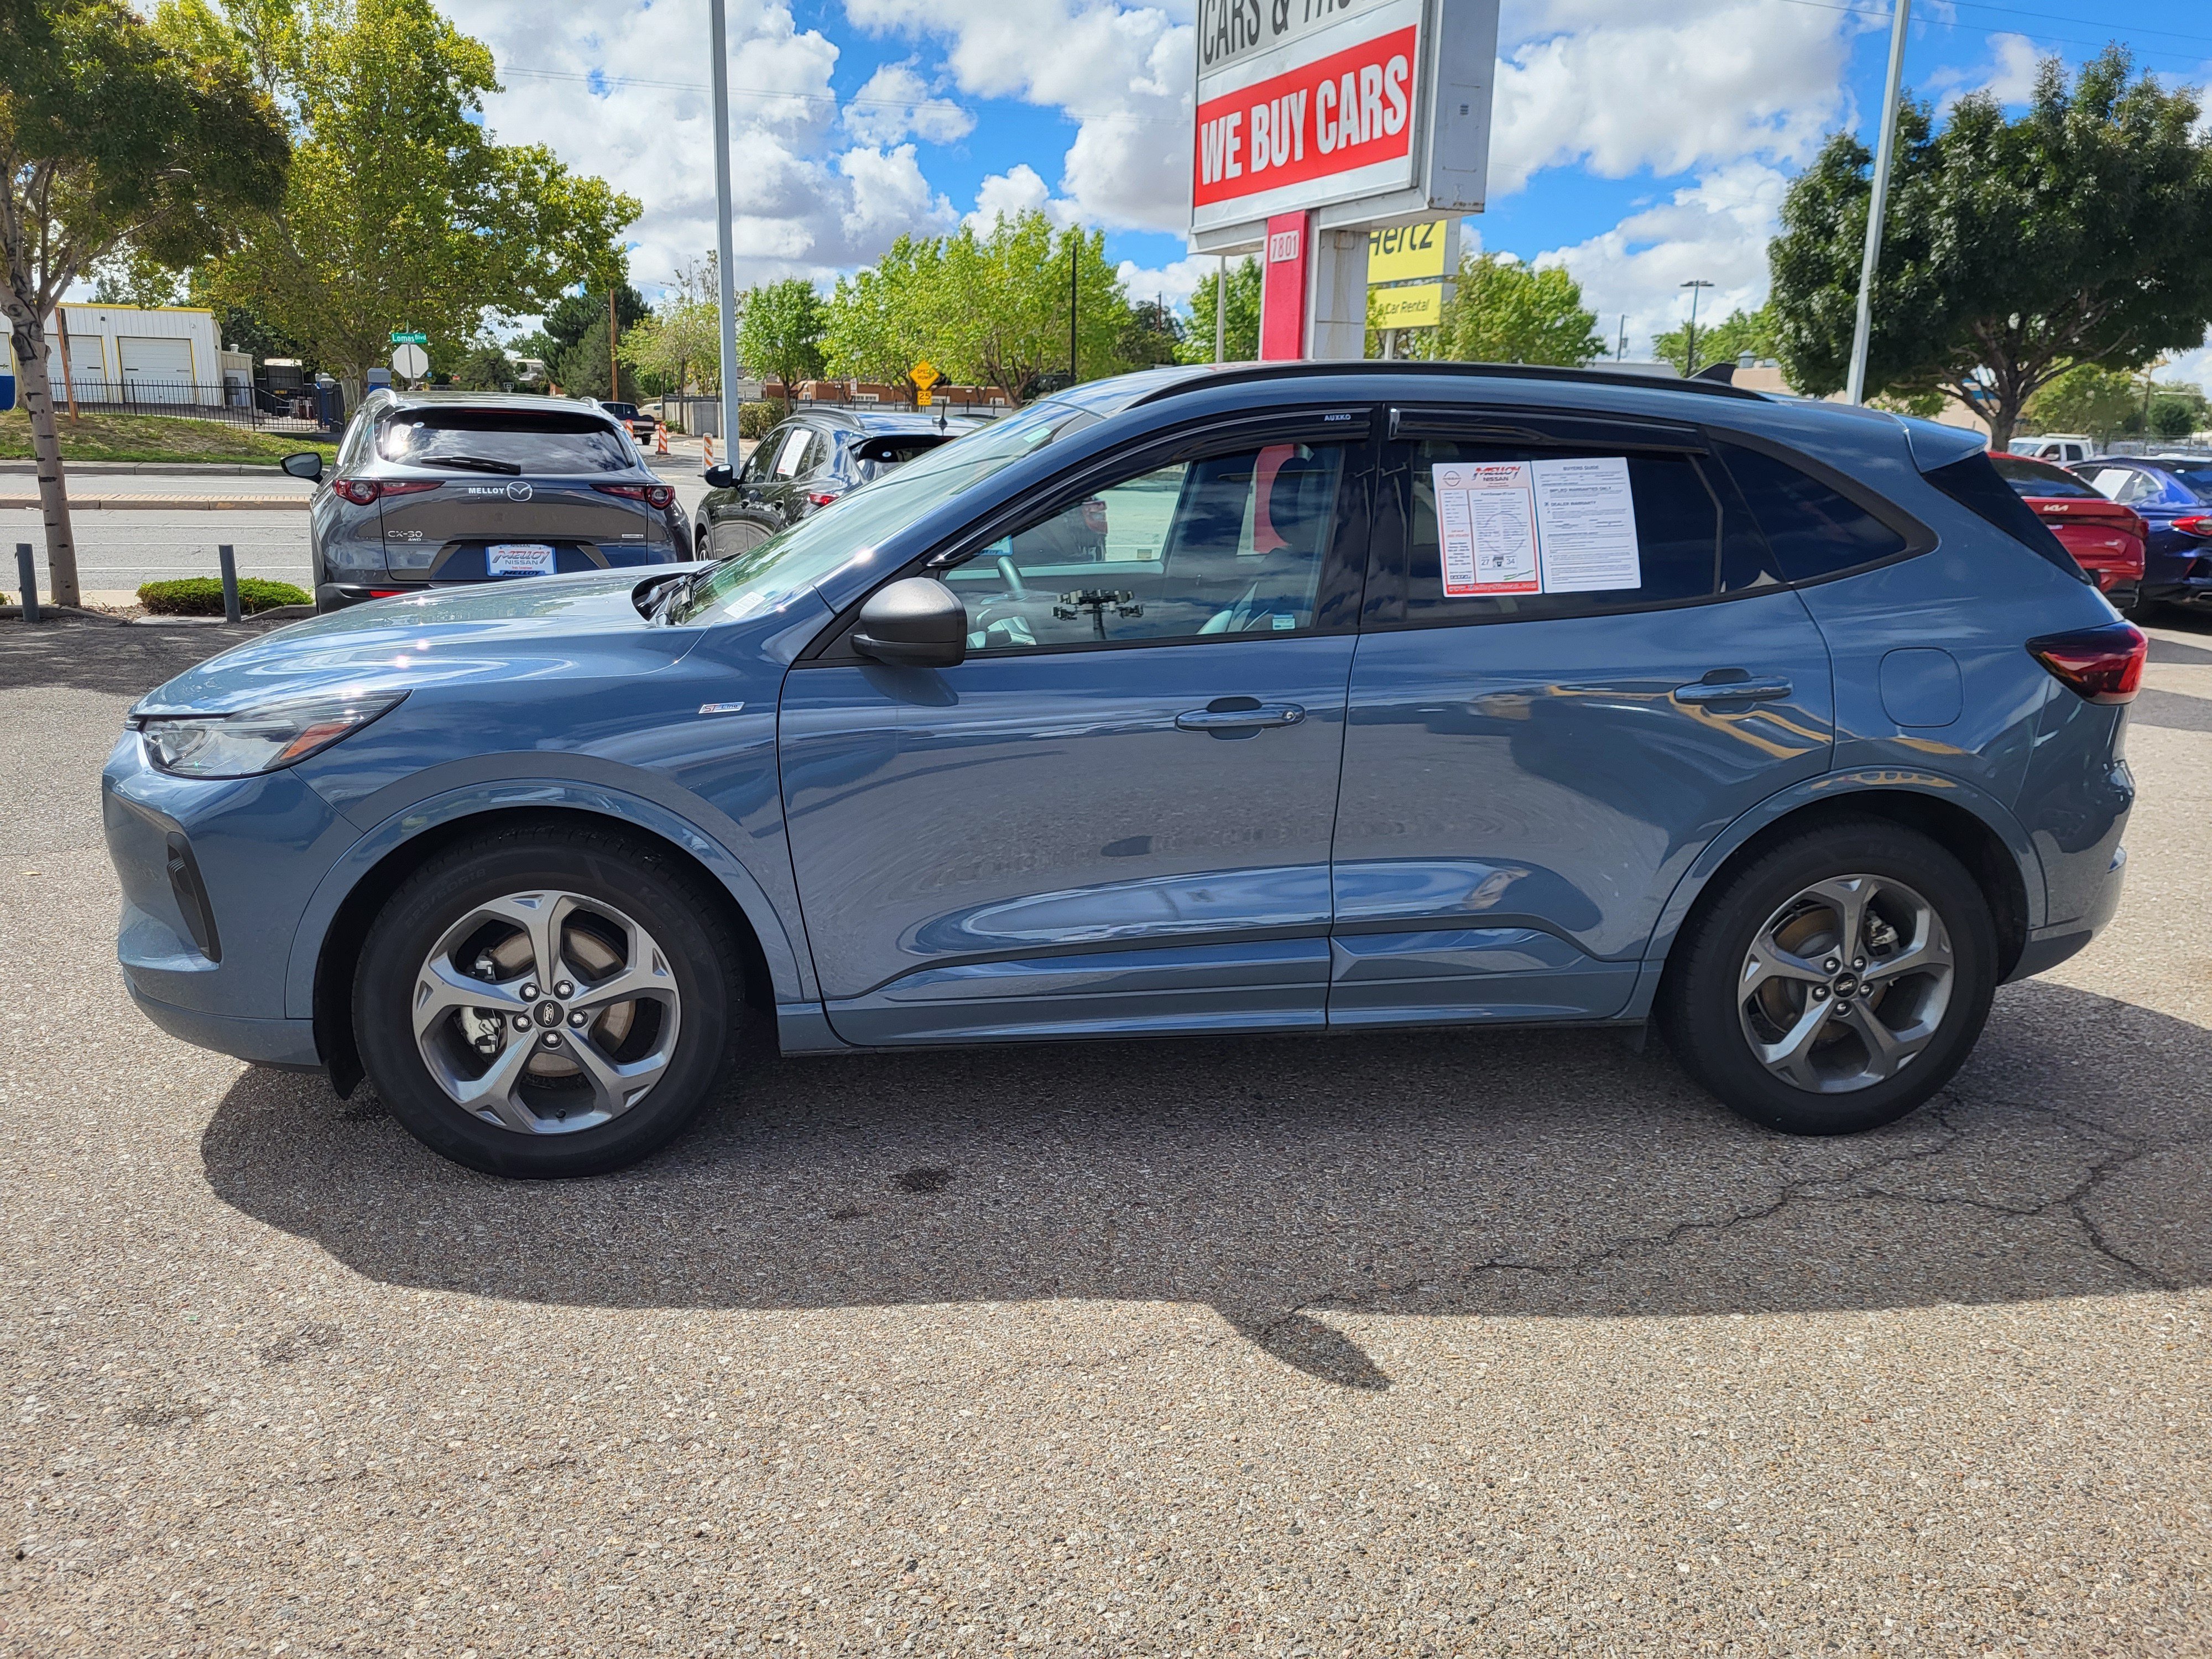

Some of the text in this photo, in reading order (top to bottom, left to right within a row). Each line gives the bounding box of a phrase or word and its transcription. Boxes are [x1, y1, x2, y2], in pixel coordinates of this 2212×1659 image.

[1204, 0, 1260, 65] CARS
[1201, 54, 1408, 185] WE BUY CARS
[1272, 235, 1297, 259] 7801
[1385, 302, 1400, 314] Car
[1400, 299, 1430, 314] Rental
[492, 551, 550, 564] MELLOY
